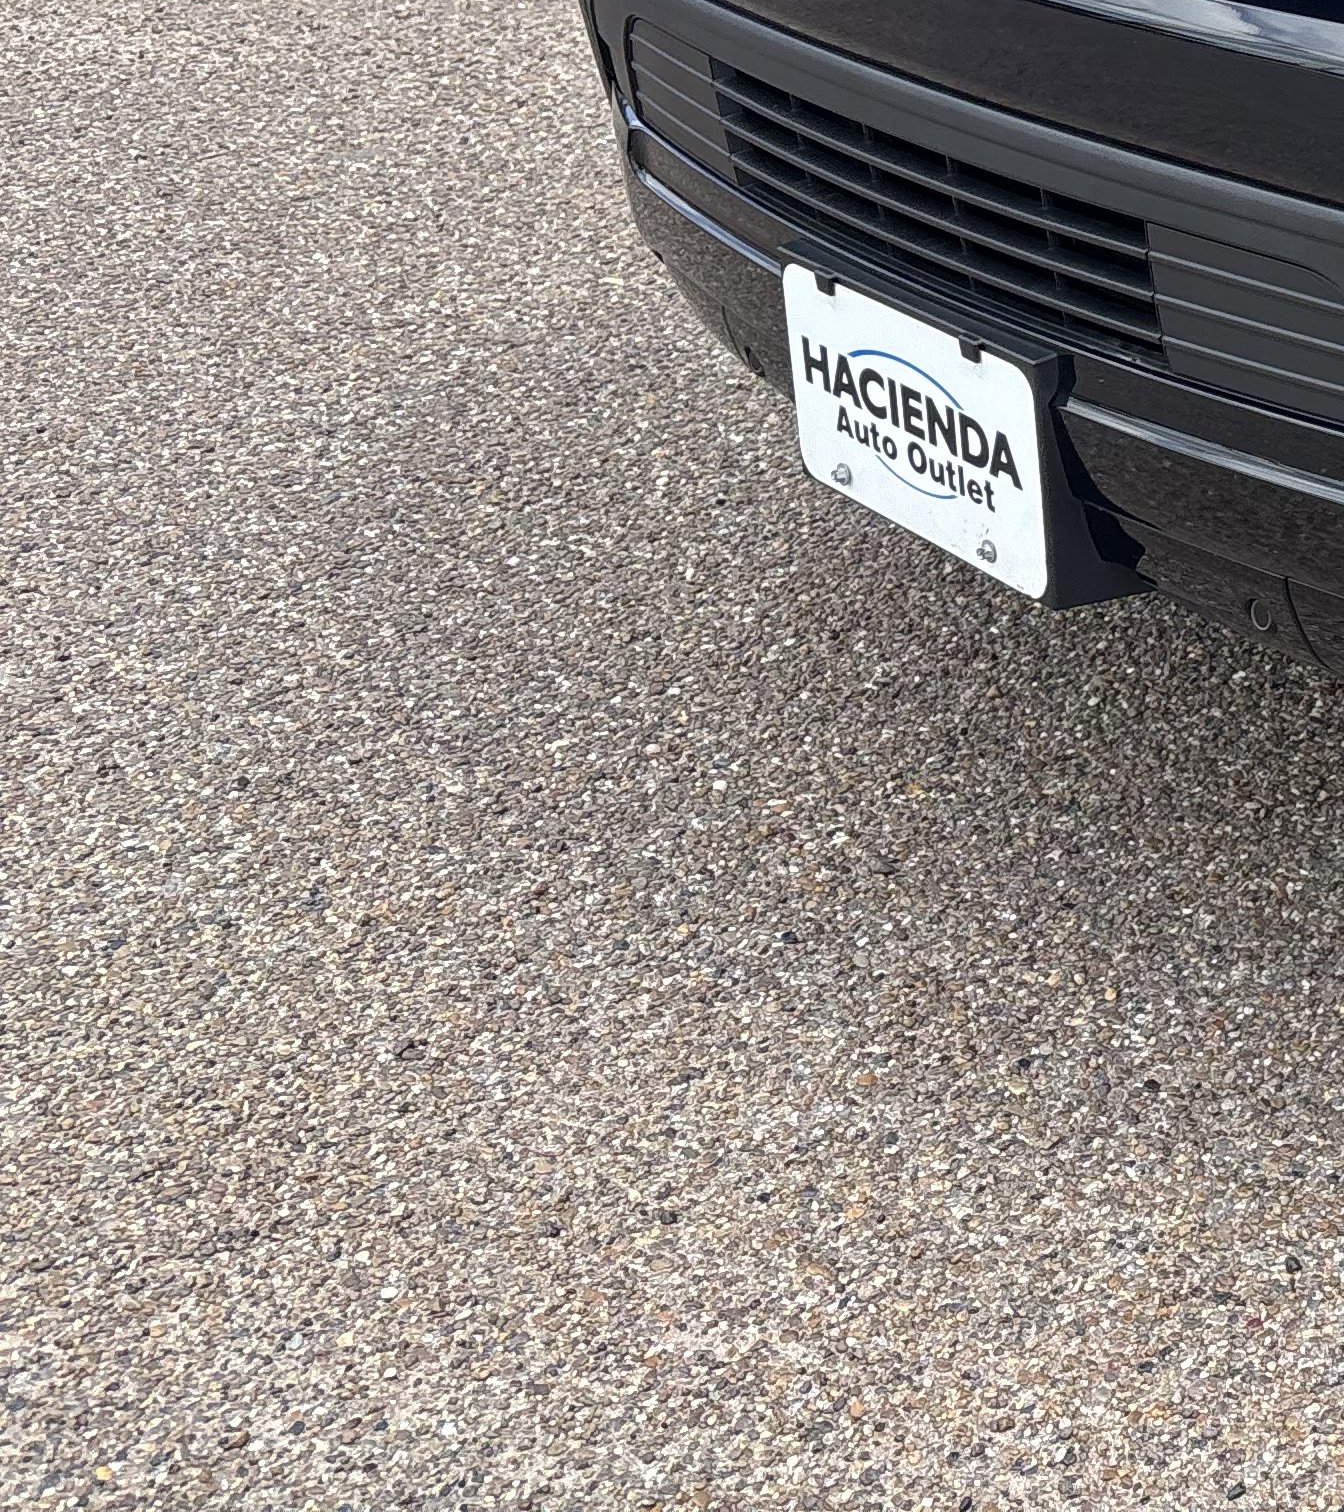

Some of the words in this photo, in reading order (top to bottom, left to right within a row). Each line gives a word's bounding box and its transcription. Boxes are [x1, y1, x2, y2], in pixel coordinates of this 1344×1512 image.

[801, 335, 1023, 491] HACIENDA
[837, 404, 898, 461] Auto
[907, 440, 996, 513] Outlet
